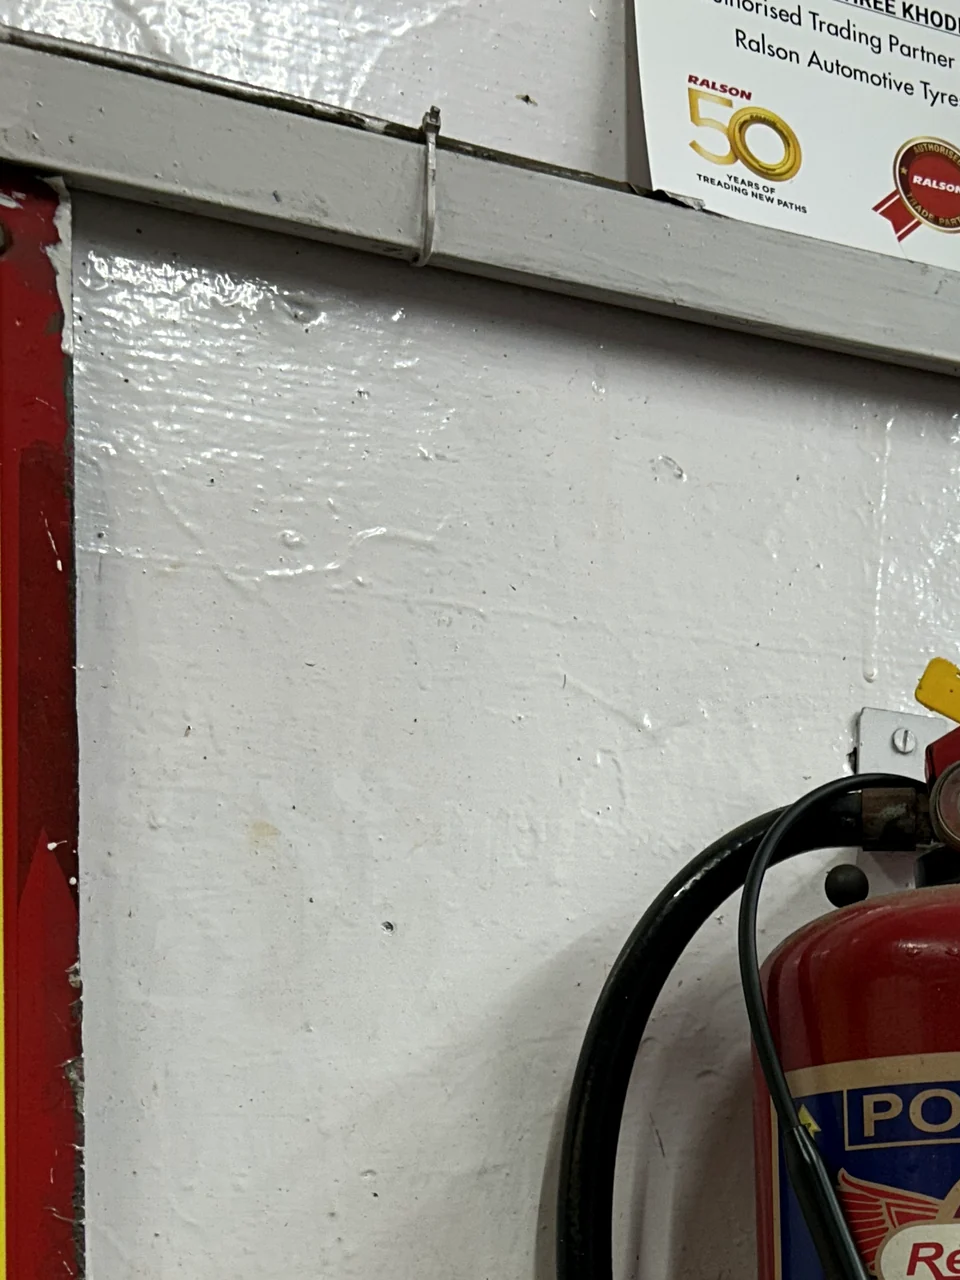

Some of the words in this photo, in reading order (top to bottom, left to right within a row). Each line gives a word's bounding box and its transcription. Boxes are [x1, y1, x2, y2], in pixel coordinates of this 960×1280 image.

[735, 28, 800, 64] Ralson
[807, 51, 914, 96] Automotive
[808, 10, 882, 54] Trading
[889, 34, 955, 69] Partner
[688, 74, 752, 100] RALSON
[688, 87, 802, 182] 50
[696, 173, 748, 196] TREADING
[751, 191, 774, 204] NEW
[777, 199, 807, 214] PATHS
[726, 174, 760, 190] YEARS
[762, 185, 776, 195] OF
